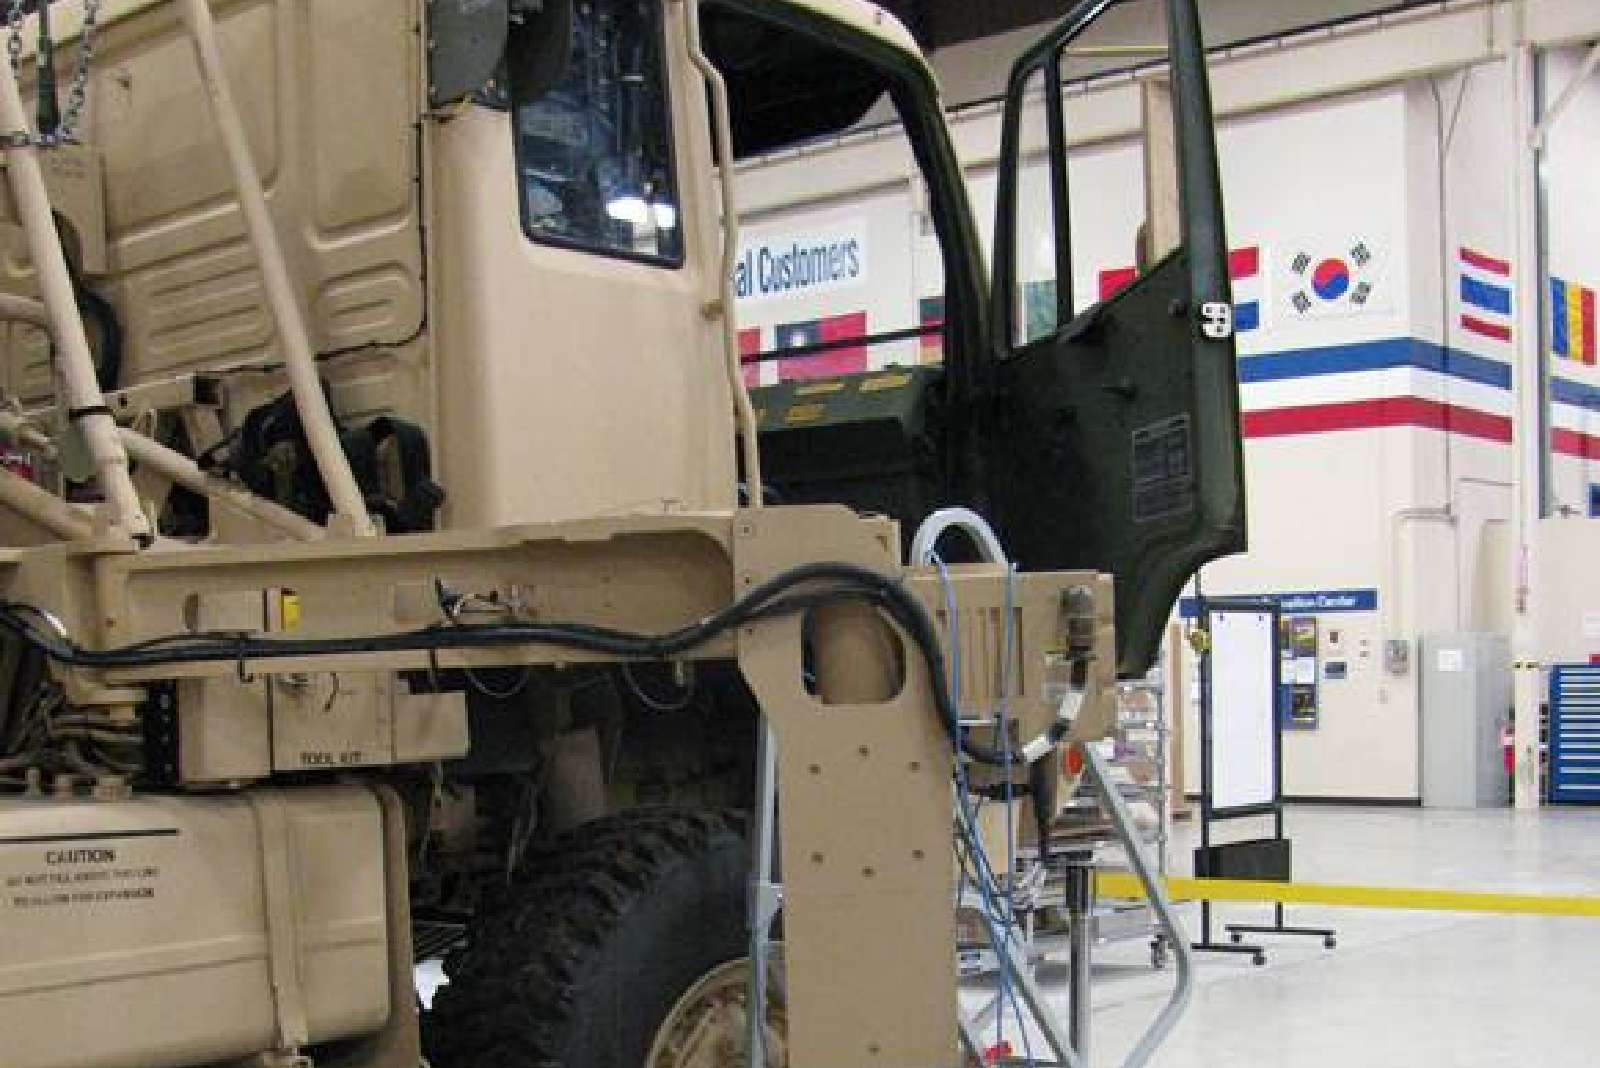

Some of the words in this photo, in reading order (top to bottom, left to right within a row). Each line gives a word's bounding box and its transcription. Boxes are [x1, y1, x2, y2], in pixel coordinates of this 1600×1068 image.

[757, 239, 859, 293] Customers
[300, 751, 336, 765] TOOL
[340, 751, 362, 763] KIT
[46, 849, 116, 865] CAUTION
